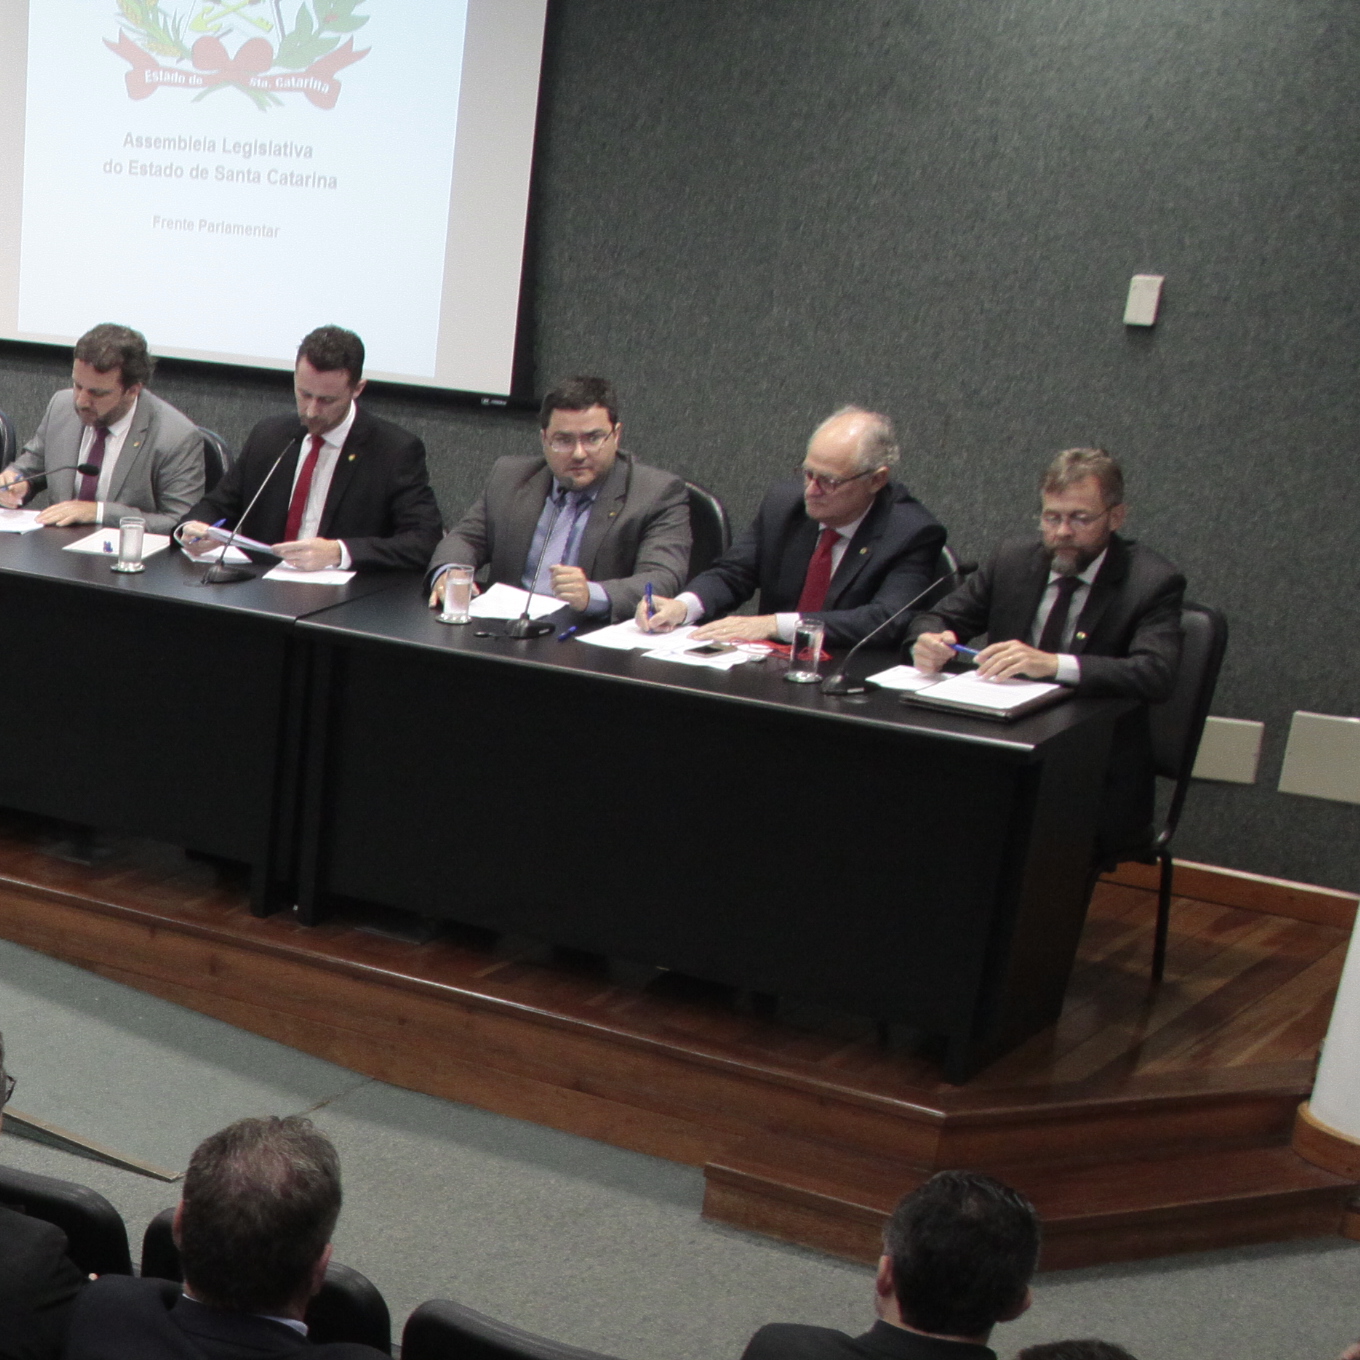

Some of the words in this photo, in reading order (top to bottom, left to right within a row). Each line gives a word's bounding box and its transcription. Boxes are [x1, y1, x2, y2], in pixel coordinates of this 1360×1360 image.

[123, 131, 216, 153] Assembleia
[222, 138, 313, 160] Legislativa
[103, 158, 123, 175] do
[128, 159, 183, 179] Estado
[189, 163, 209, 181] de
[214, 165, 261, 184] Santa
[267, 168, 338, 190] Catarina
[152, 215, 194, 231] Frente
[198, 218, 280, 238] Parlamentar
